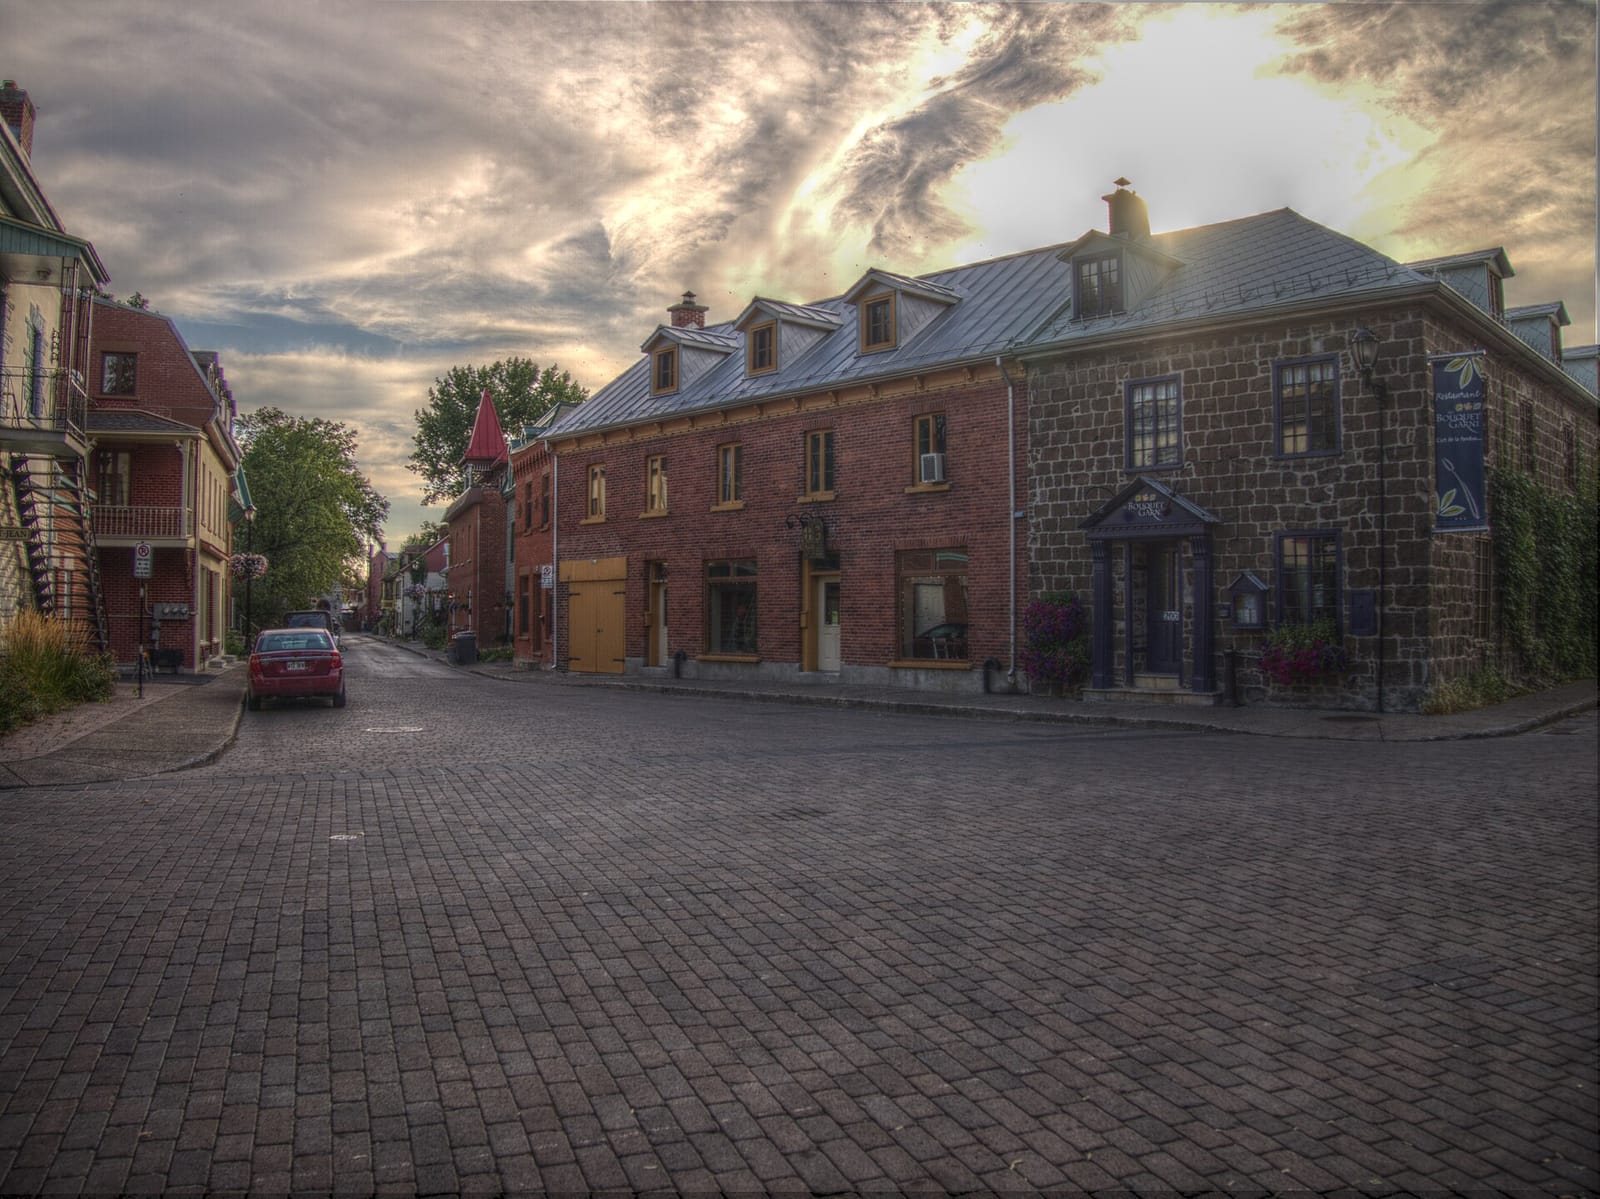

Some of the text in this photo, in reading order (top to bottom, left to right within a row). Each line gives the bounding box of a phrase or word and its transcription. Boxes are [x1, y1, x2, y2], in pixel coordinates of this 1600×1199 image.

[1436, 390, 1480, 401] Restaurant
[1436, 413, 1480, 423] BOUQUET
[1448, 420, 1480, 433] GARNI
[1128, 502, 1166, 512] BOUQUET
